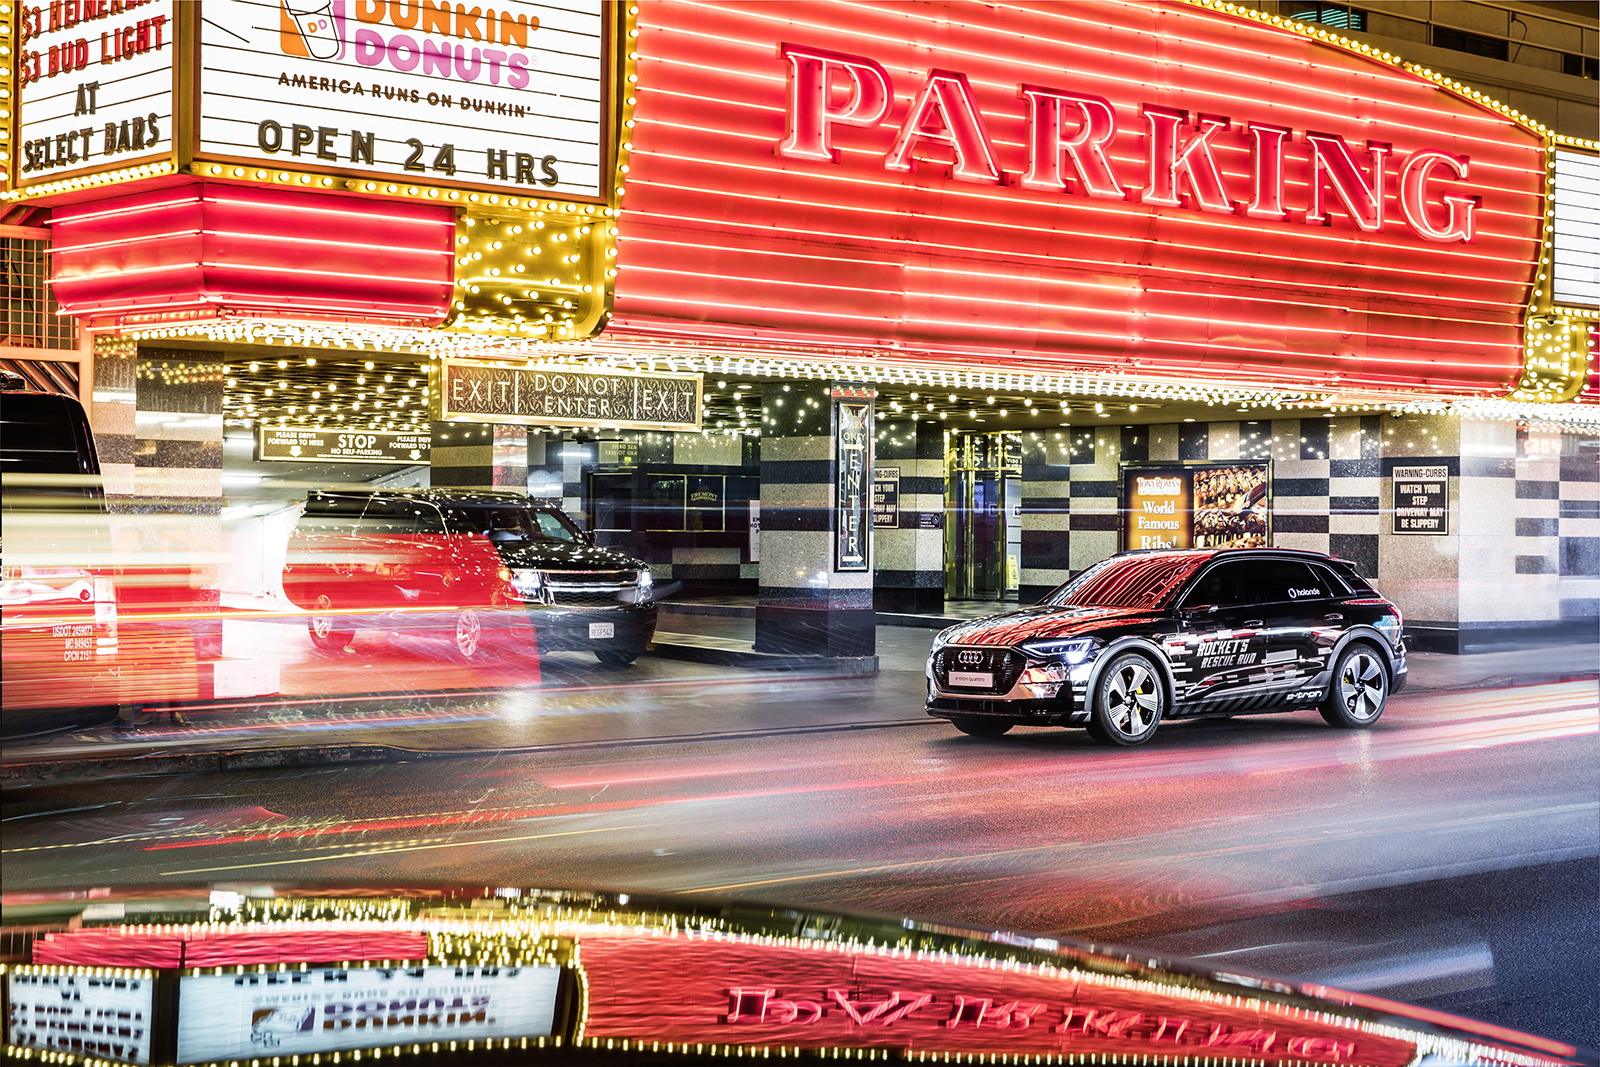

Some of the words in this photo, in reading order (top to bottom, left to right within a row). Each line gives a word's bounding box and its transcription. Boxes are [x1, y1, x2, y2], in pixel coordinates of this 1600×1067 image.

[355, 0, 540, 49] DUNKIN'
[19, 50, 41, 89] $3
[48, 38, 89, 78] BUD
[101, 14, 166, 65] LIGHT
[355, 28, 530, 89] DONUTS
[74, 81, 100, 116] AT
[278, 72, 364, 96] AMERICA
[372, 84, 420, 103] RUNS
[427, 92, 451, 108] ON
[460, 97, 532, 118] DUNKIN'
[22, 127, 94, 173] SELECT
[104, 113, 160, 155] BARS
[774, 42, 1482, 244] PARKING
[258, 119, 375, 165] OPEN
[403, 137, 457, 176] 24
[487, 148, 559, 187] HRS
[453, 379, 511, 403] EXIT
[535, 374, 567, 393] DO
[576, 377, 620, 396] NOT
[544, 396, 610, 416] ENTER
[643, 389, 694, 413] EXIT
[276, 431, 297, 439] PLEASE
[338, 434, 377, 449] STOP
[397, 436, 418, 444] PLEASE
[843, 432, 866, 441] ONLY
[342, 448, 383, 456] SELF-PARKING
[1394, 468, 1447, 478] WARNING-CURBS
[1400, 484, 1423, 494] WATCH
[1424, 484, 1441, 494] YOUR
[846, 453, 860, 553] ENTER
[1142, 500, 1175, 514] World
[1412, 495, 1428, 505] STEP
[873, 514, 893, 523] SLIPPERY
[1396, 507, 1428, 517] DRIVEWAY
[1429, 507, 1444, 517] MAY
[1138, 516, 1179, 530] Famous
[1401, 519, 1410, 528] BE
[1410, 518, 1440, 529] SLIPPERY
[1140, 535, 1177, 549] Ribs!
[52, 626, 71, 637] USDOT
[65, 638, 74, 649] MC
[1196, 638, 1250, 656] ROCKET'S
[63, 650, 80, 661] CPCN
[80, 650, 92, 661] 2151
[1200, 655, 1236, 668] RESCUE
[1236, 653, 1257, 665] RUN
[1286, 689, 1323, 700] e-tron
